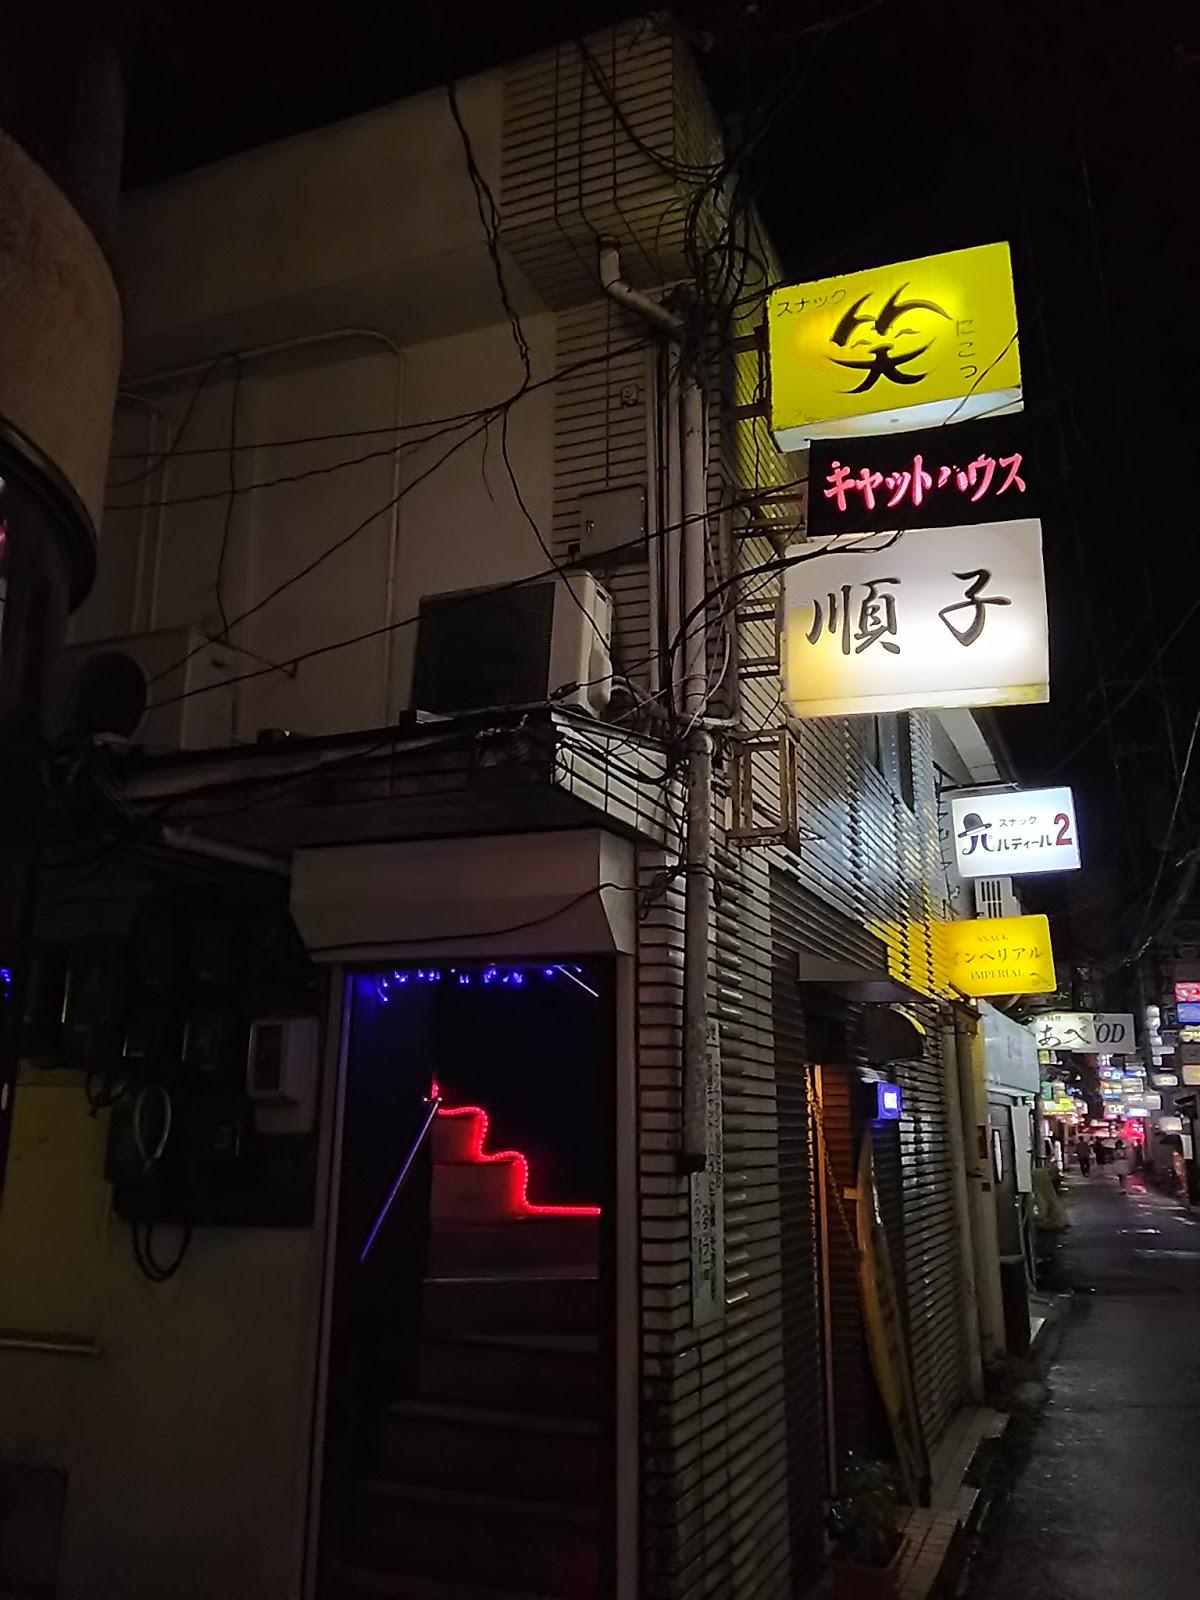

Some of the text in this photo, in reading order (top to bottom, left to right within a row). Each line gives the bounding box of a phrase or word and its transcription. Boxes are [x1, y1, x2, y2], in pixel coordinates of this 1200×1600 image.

[776, 288, 848, 317] スナック
[823, 282, 953, 394] 笑
[805, 568, 1012, 656] 順子
[999, 815, 1037, 828] スナック
[970, 968, 1023, 980] IMPERIAL
[1093, 1022, 1126, 1044] OD
